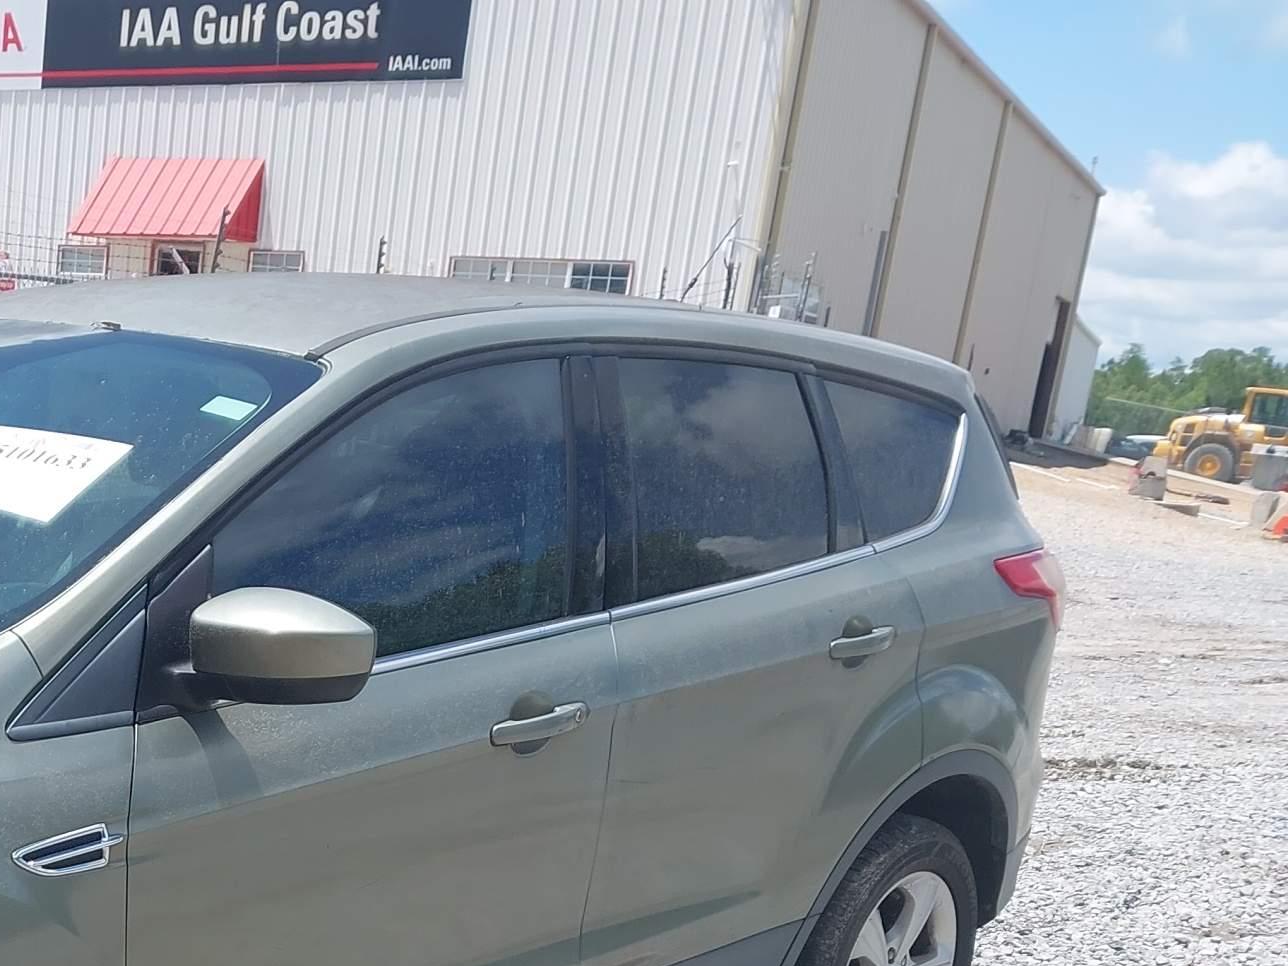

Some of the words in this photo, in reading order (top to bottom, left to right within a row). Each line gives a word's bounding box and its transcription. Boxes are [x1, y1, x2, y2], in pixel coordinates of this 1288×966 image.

[120, 8, 181, 48] IAA
[193, 4, 265, 46] Gulf
[276, 0, 381, 42] Coast
